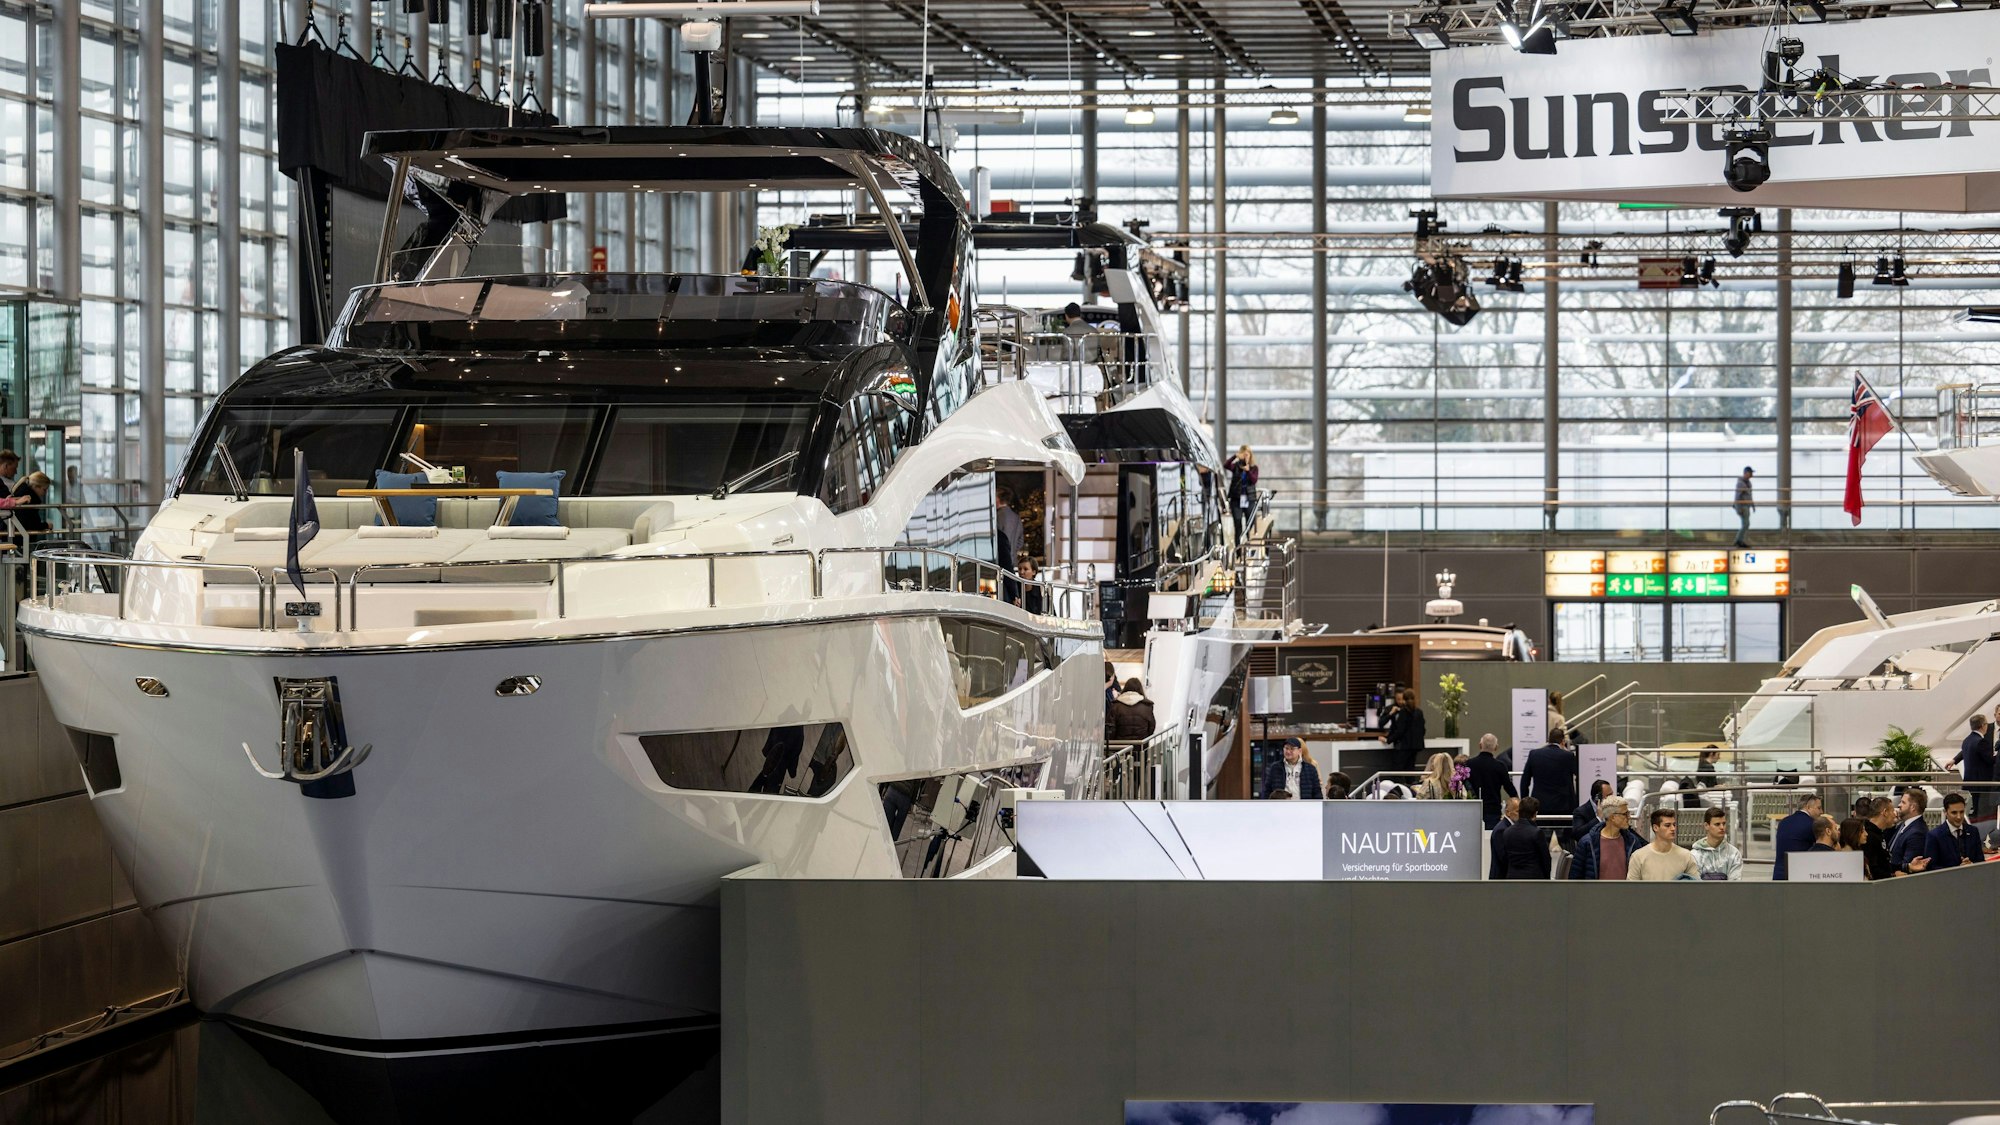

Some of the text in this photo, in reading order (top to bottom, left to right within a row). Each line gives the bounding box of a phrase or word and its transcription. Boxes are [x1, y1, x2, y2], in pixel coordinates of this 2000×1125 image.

[1452, 54, 1992, 163] Sunseeker
[1341, 862, 1448, 874] Versicherung für Sportboote
